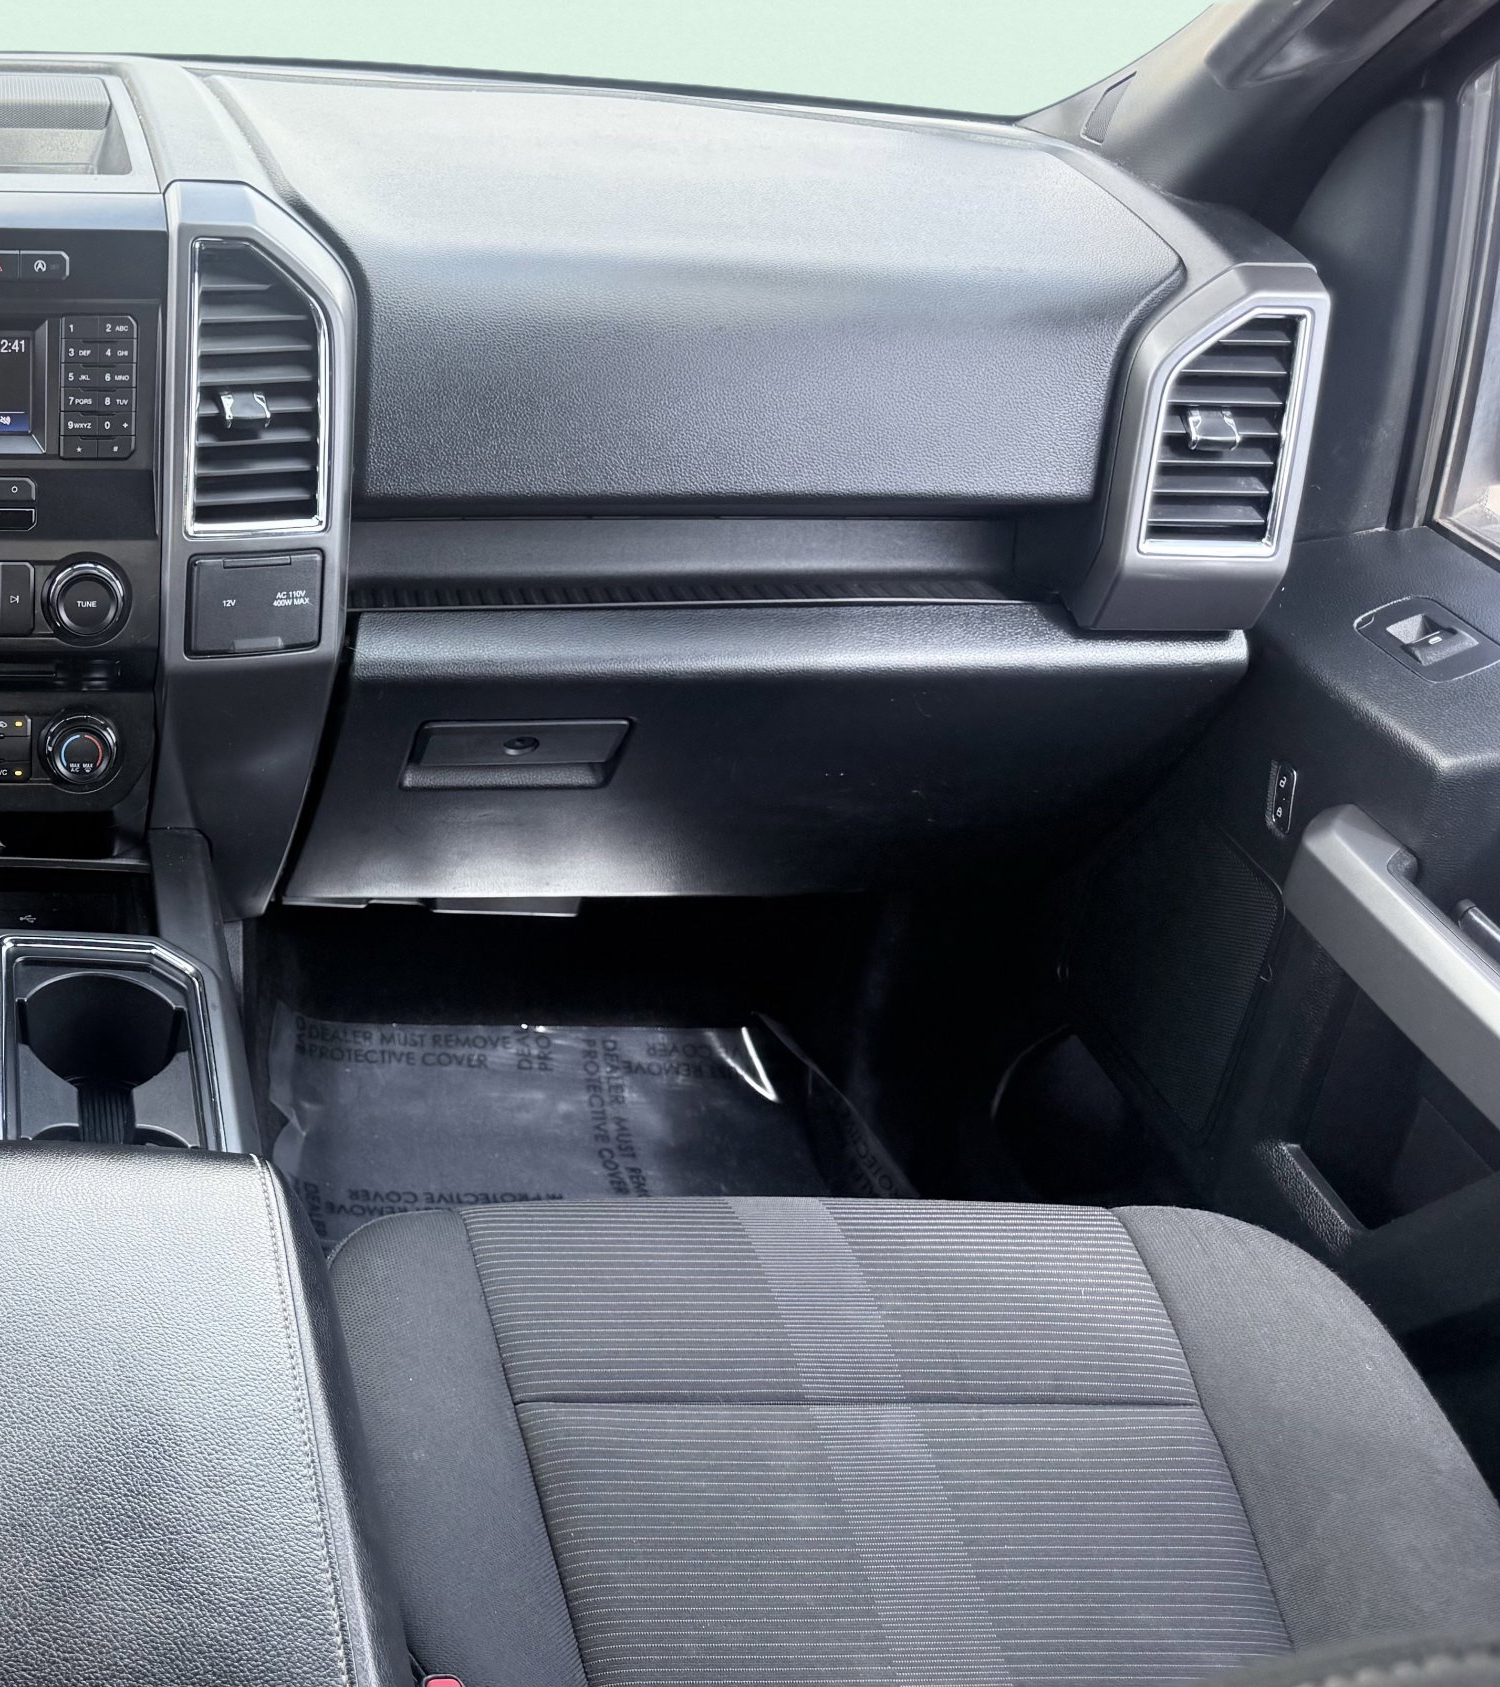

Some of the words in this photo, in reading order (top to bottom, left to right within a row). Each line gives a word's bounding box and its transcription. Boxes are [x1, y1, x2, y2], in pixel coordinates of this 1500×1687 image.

[69, 324, 75, 333] 1
[105, 323, 112, 332] 2
[0, 339, 26, 353] 2:41
[68, 348, 75, 357] 3
[105, 348, 112, 357] 4
[68, 372, 75, 381] 5
[104, 372, 112, 381] 6
[68, 396, 75, 405] 7
[104, 397, 111, 406] 8
[67, 421, 74, 430] 9
[104, 421, 111, 430] 0
[276, 591, 287, 599] AC
[289, 590, 306, 598] 110V
[76, 600, 97, 608] TUNE
[223, 599, 236, 607] 12V
[272, 599, 292, 607] 400W
[293, 597, 310, 606] MAX
[307, 1023, 373, 1046] DEALER
[380, 1032, 426, 1048] MUST
[432, 1033, 511, 1050] REMOVE
[645, 1041, 713, 1058] COVER
[308, 1043, 416, 1066] PROTECTIVE
[421, 1051, 489, 1068] COVER
[580, 1037, 611, 1143] PROTECTIVE
[597, 1147, 630, 1196] COVER
[613, 1116, 637, 1160] MUST
[347, 1188, 418, 1204] COVER
